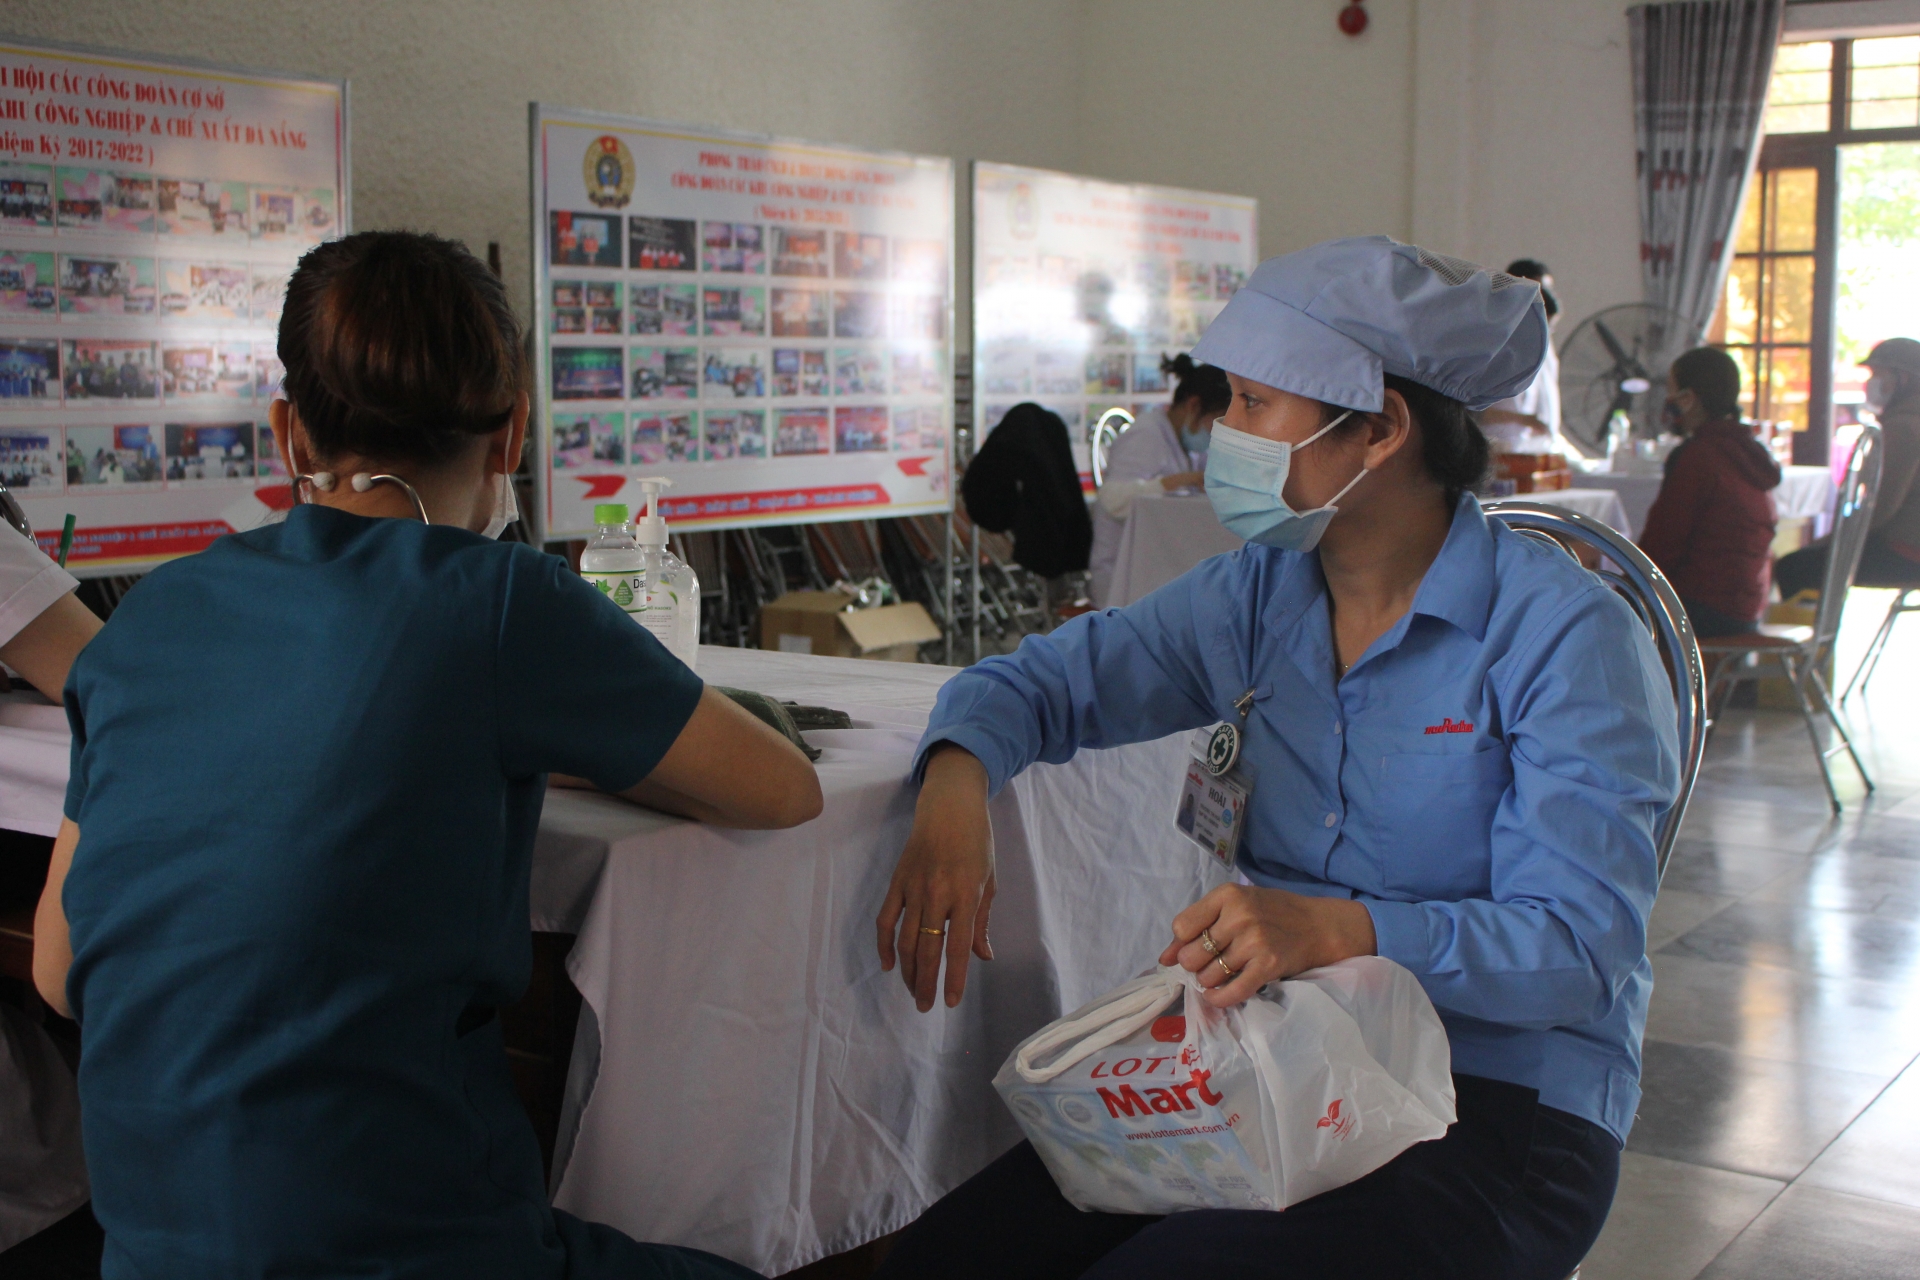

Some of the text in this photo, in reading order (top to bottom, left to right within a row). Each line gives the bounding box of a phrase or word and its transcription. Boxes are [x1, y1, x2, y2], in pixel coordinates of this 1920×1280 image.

[13, 63, 45, 95] HỘI
[49, 67, 82, 96] CÁC
[87, 72, 130, 100] CÔNG
[34, 98, 80, 127] CÔNG
[85, 106, 146, 137] NGHIỆP
[150, 115, 162, 135] &
[166, 112, 196, 139] CHẾ
[68, 136, 143, 164] 2017-2022
[1217, 725, 1235, 747] SAFETY
[1208, 786, 1227, 809] HOÀI
[1096, 1068, 1224, 1119] Mart
[1125, 1112, 1241, 1141] www.lottemart.com.vn
